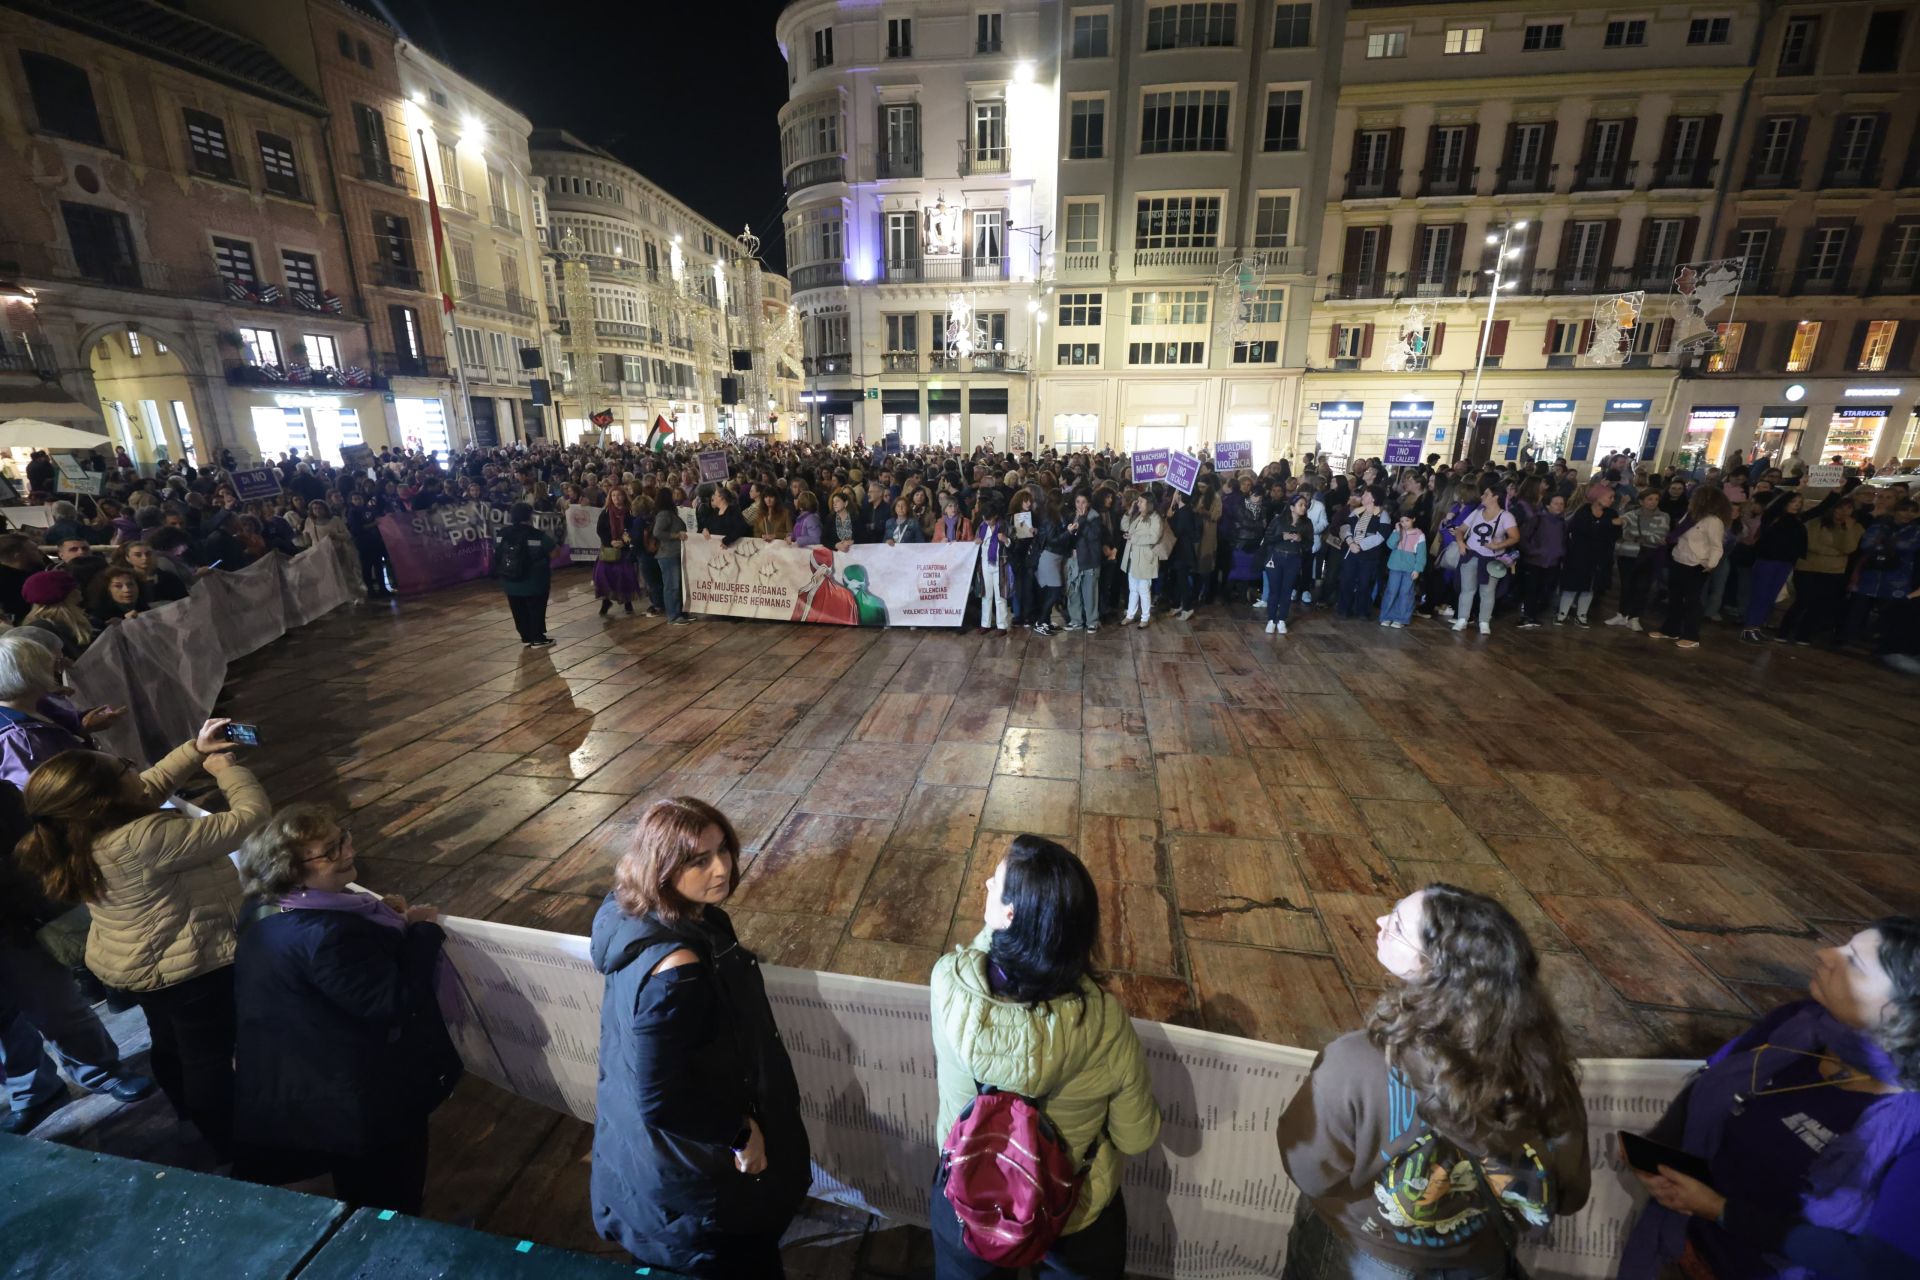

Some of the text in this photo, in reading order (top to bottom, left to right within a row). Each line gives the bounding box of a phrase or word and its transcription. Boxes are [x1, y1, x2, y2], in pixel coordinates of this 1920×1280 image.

[1218, 442, 1250, 452] IGUALDAD
[1142, 452, 1166, 461] MACHISMO
[1136, 464, 1154, 473] MATA
[1216, 459, 1251, 468] VIOLENCIA
[441, 508, 470, 528] ES
[474, 502, 563, 530] VIOLNCIA
[697, 580, 787, 596] LAS MUJERES AFGANAS
[692, 592, 791, 608] SON NUESTRAS HERMANAS
